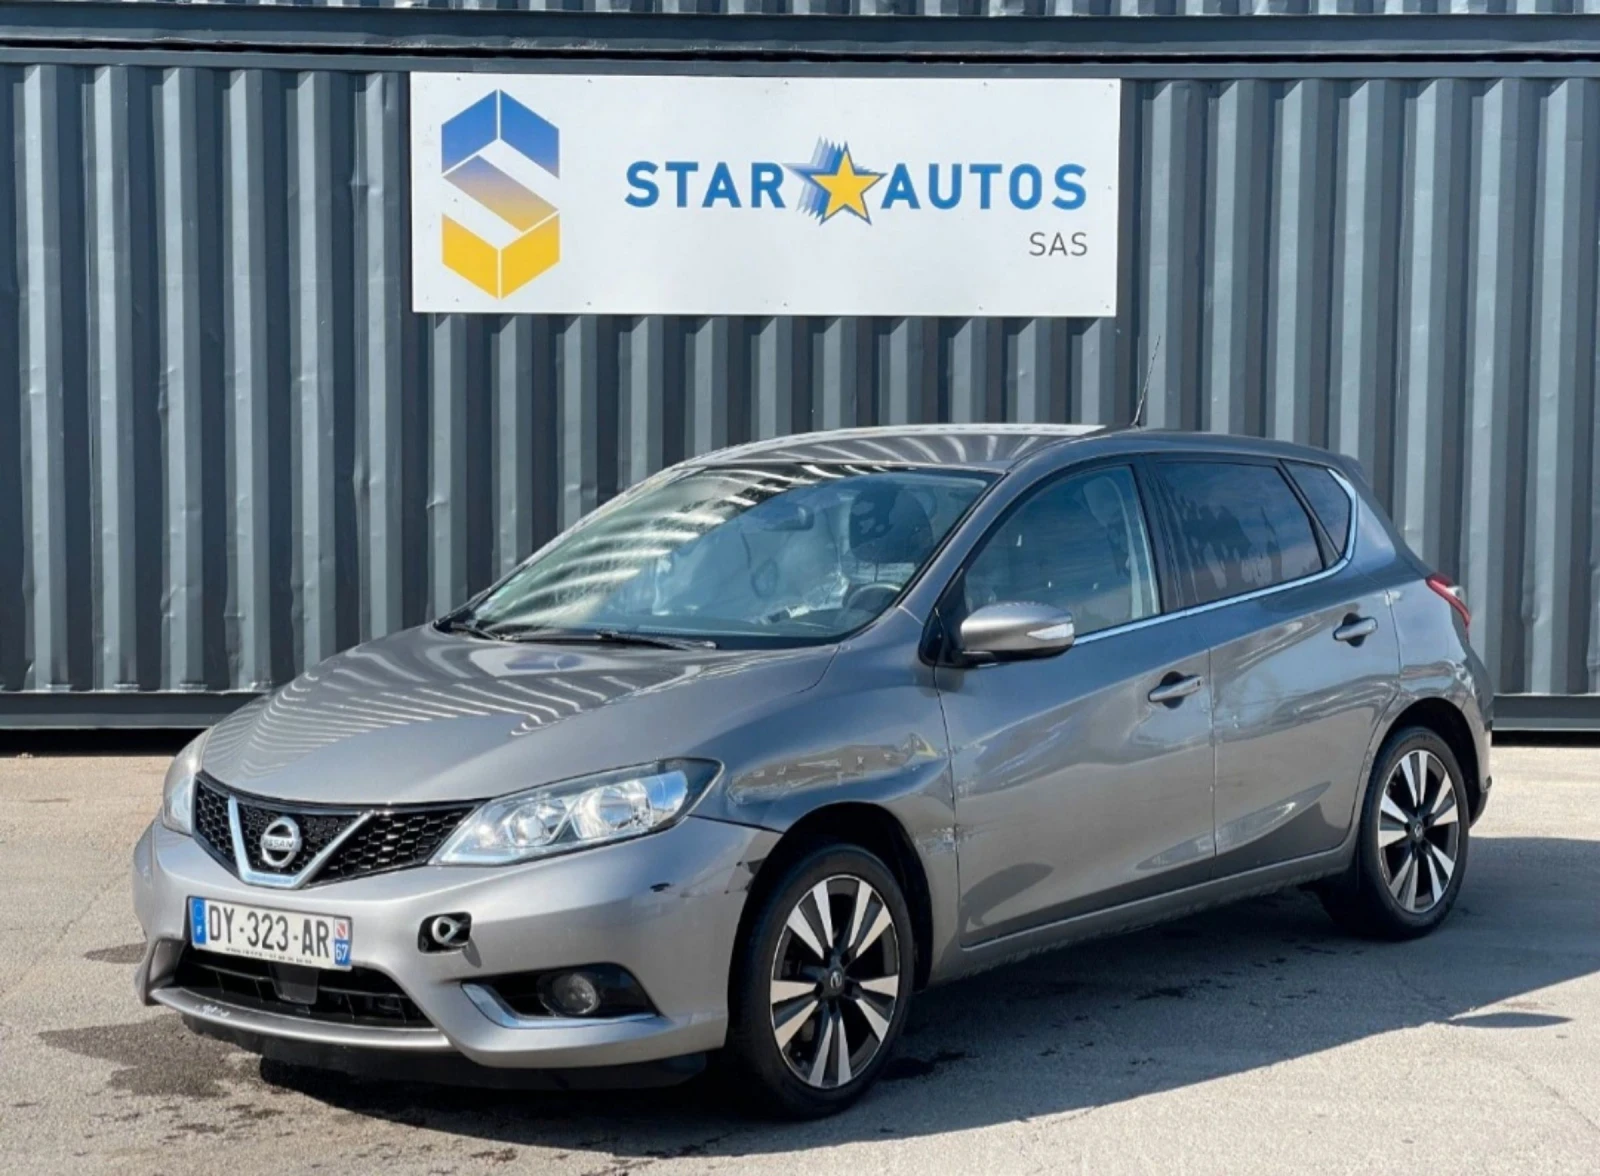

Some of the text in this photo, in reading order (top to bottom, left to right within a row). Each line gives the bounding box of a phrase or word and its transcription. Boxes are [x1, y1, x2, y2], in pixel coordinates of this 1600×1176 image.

[625, 161, 1087, 210] STAR AUTOS
[1028, 231, 1088, 257] SAS
[335, 944, 349, 961] 67
